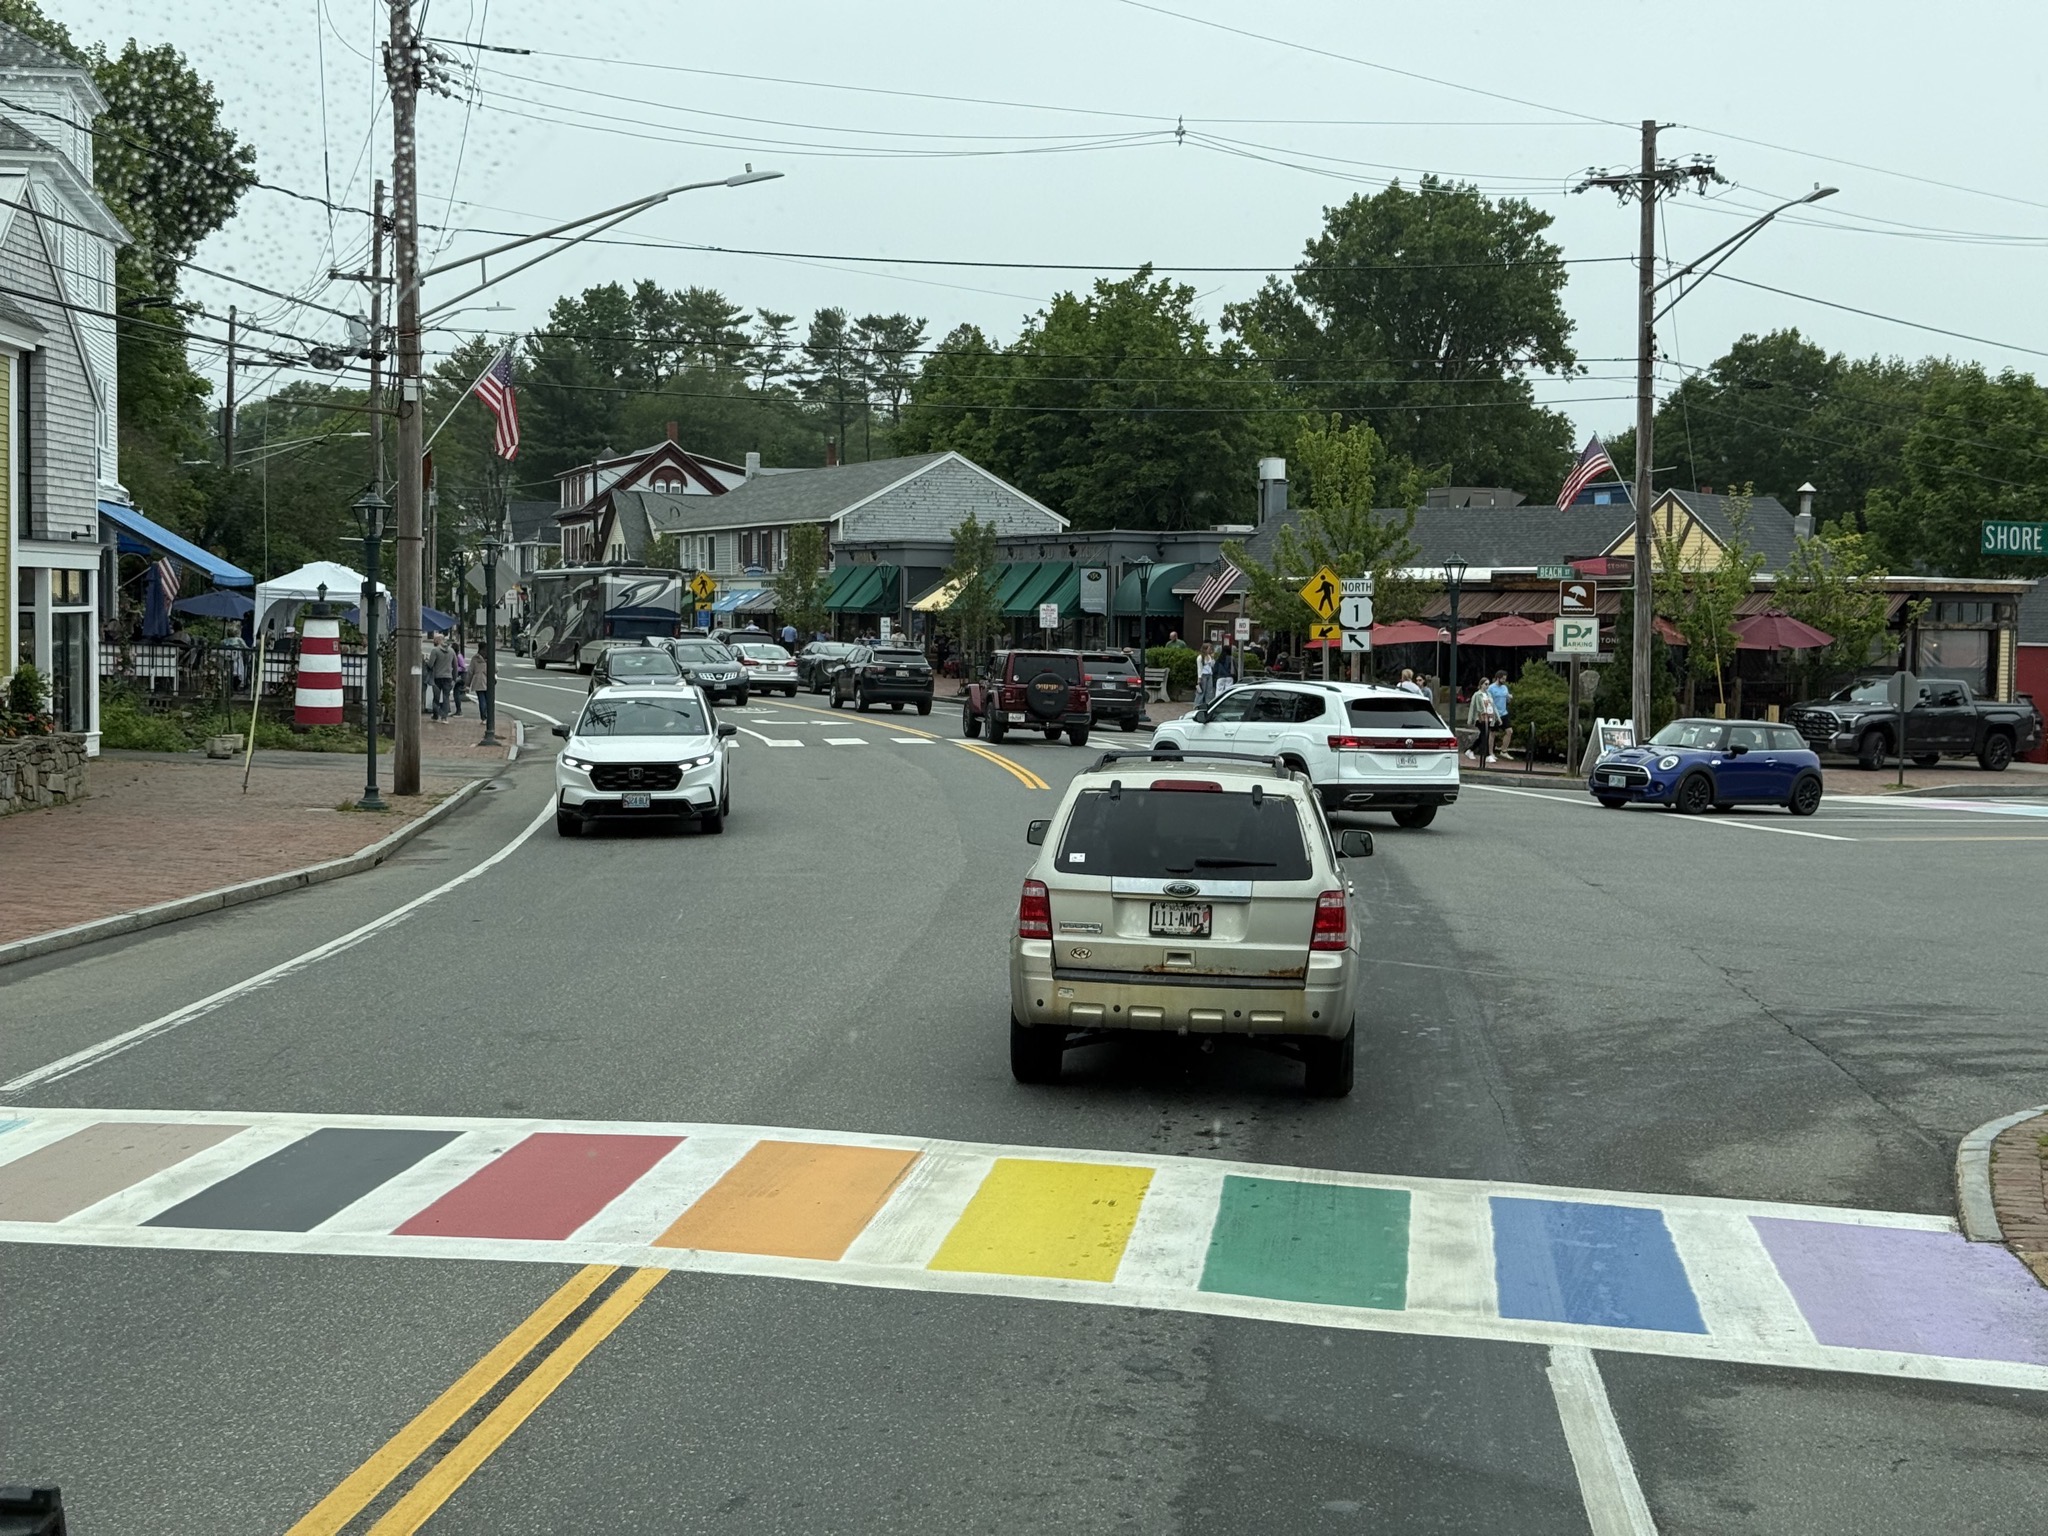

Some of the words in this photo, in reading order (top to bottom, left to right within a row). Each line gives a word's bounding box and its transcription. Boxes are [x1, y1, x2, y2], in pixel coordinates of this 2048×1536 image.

[1985, 525, 2043, 550] SHORE
[1540, 566, 1562, 577] BEACH
[1341, 582, 1372, 592] NORTH
[1353, 604, 1359, 622] 1
[1562, 624, 1593, 647] PARKING
[1154, 911, 1200, 927] 111-AMD
